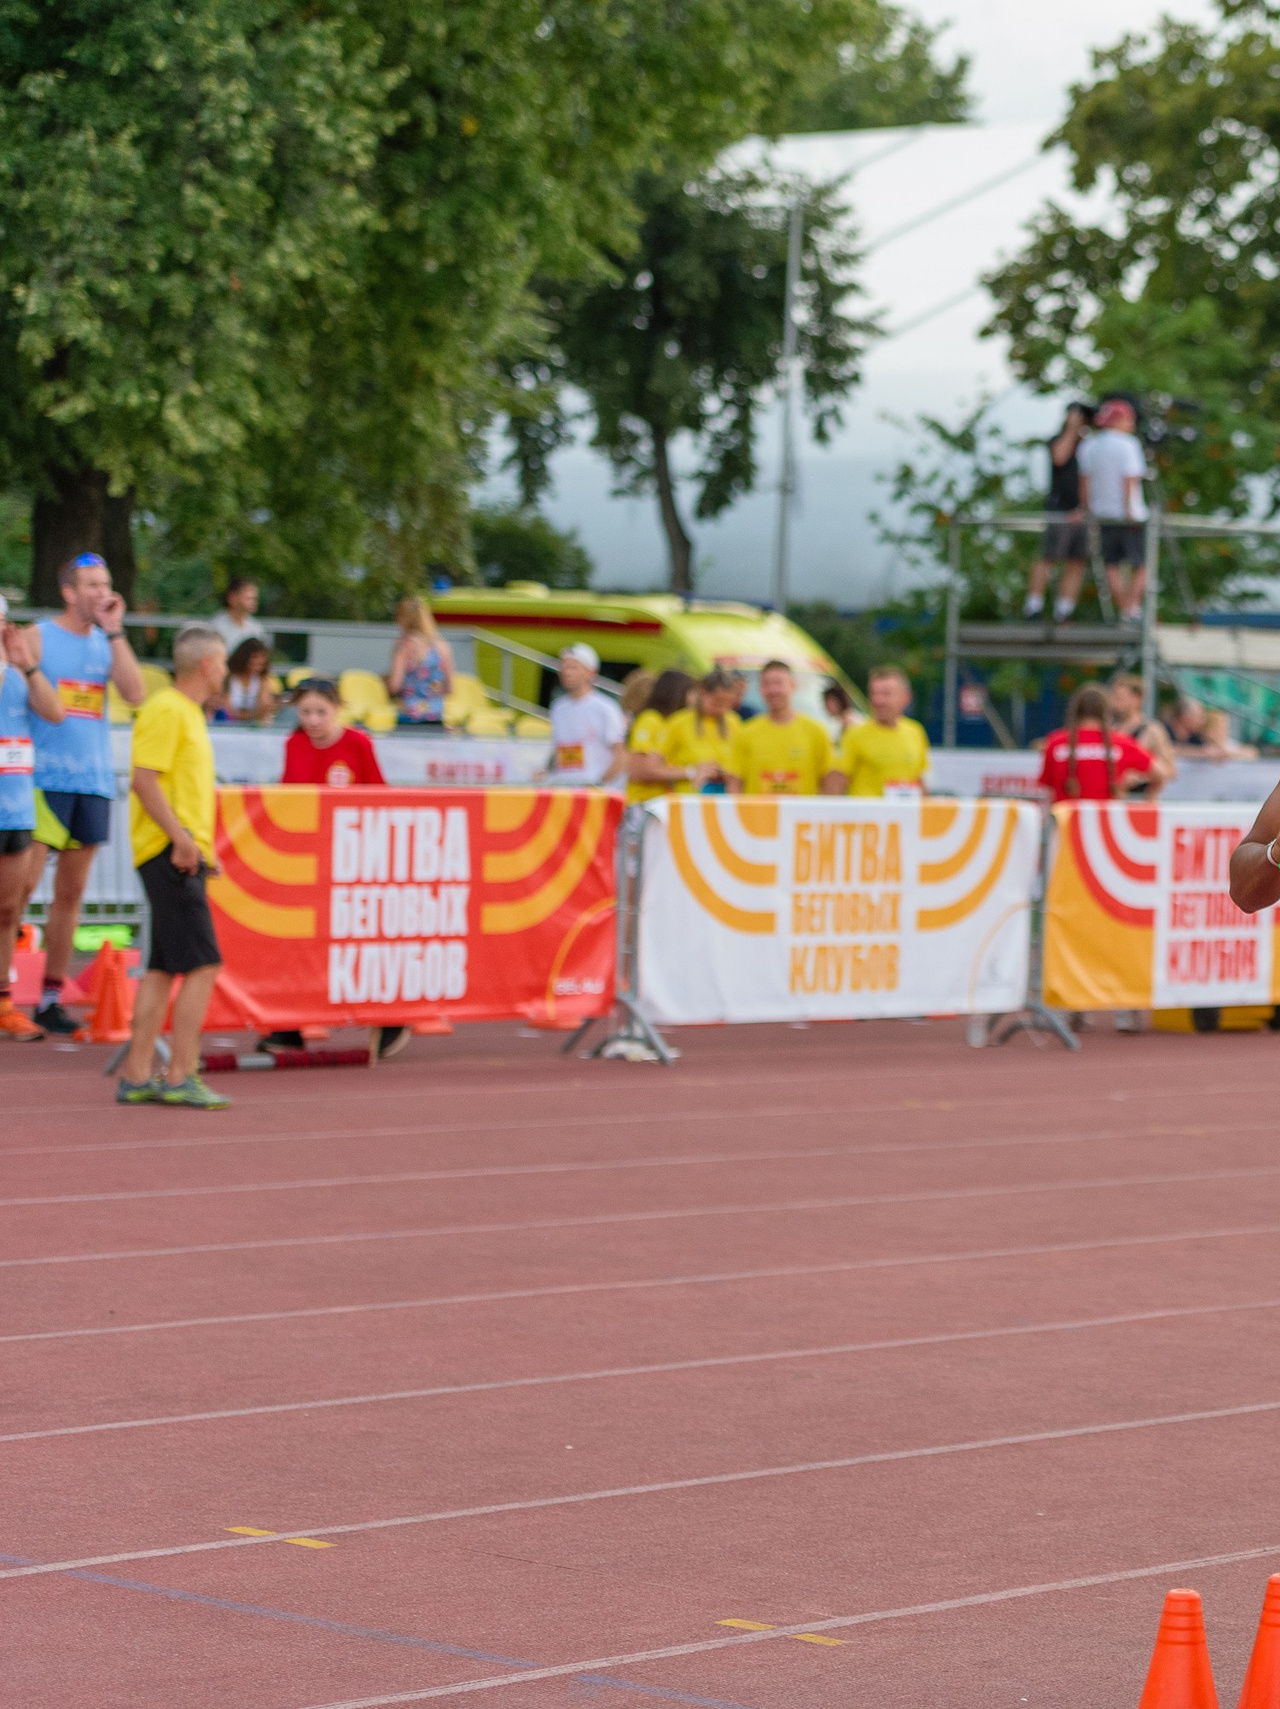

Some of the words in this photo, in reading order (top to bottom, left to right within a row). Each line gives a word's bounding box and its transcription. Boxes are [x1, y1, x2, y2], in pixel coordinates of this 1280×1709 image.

[331, 806, 470, 883] БИТВА
[794, 822, 902, 884] БИТВА
[329, 884, 470, 939] БЕГОВЫХ
[791, 892, 901, 935] БЕГОВЫХ
[328, 940, 468, 1004] КЛУБОВ
[789, 944, 899, 994] КЛУБОВ
